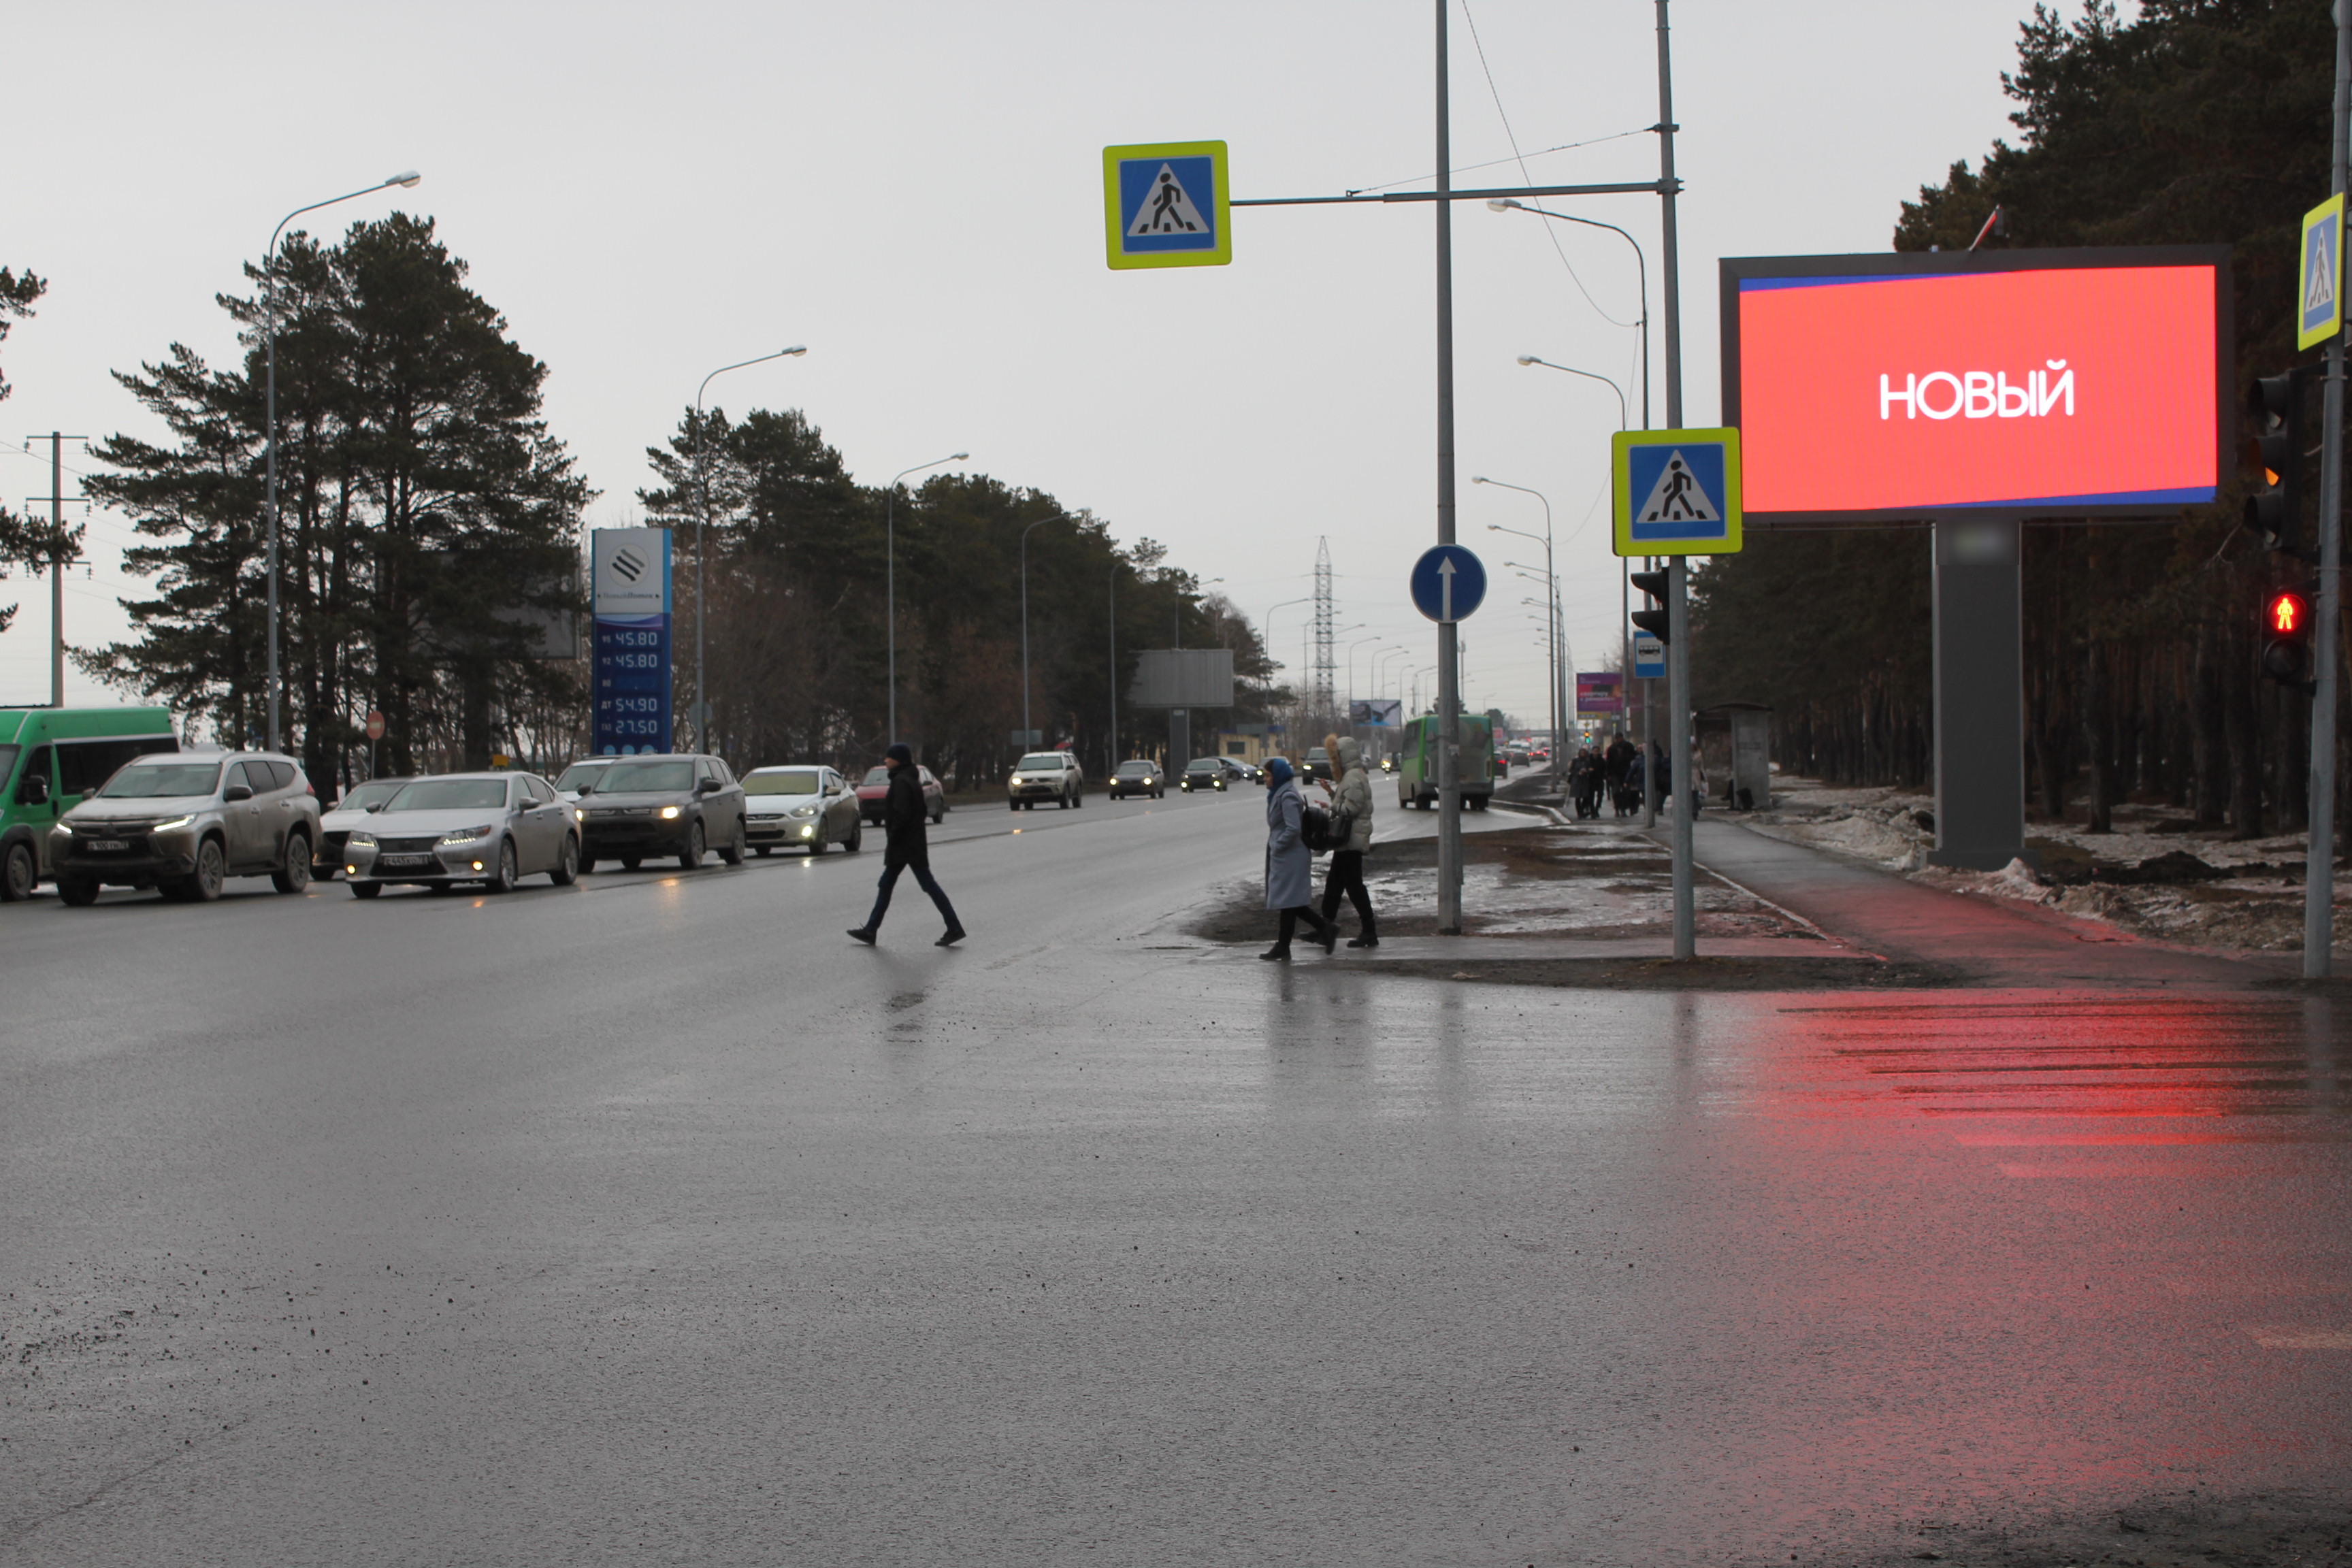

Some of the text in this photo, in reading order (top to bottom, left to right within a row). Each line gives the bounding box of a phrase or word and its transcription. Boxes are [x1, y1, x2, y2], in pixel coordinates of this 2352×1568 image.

[1880, 359, 2074, 420] НОВЫЙ
[615, 632, 657, 646] 45.80
[602, 654, 657, 668] 92 45.80
[601, 698, 657, 712] ДТ 54.90
[615, 720, 657, 734] 27.50
